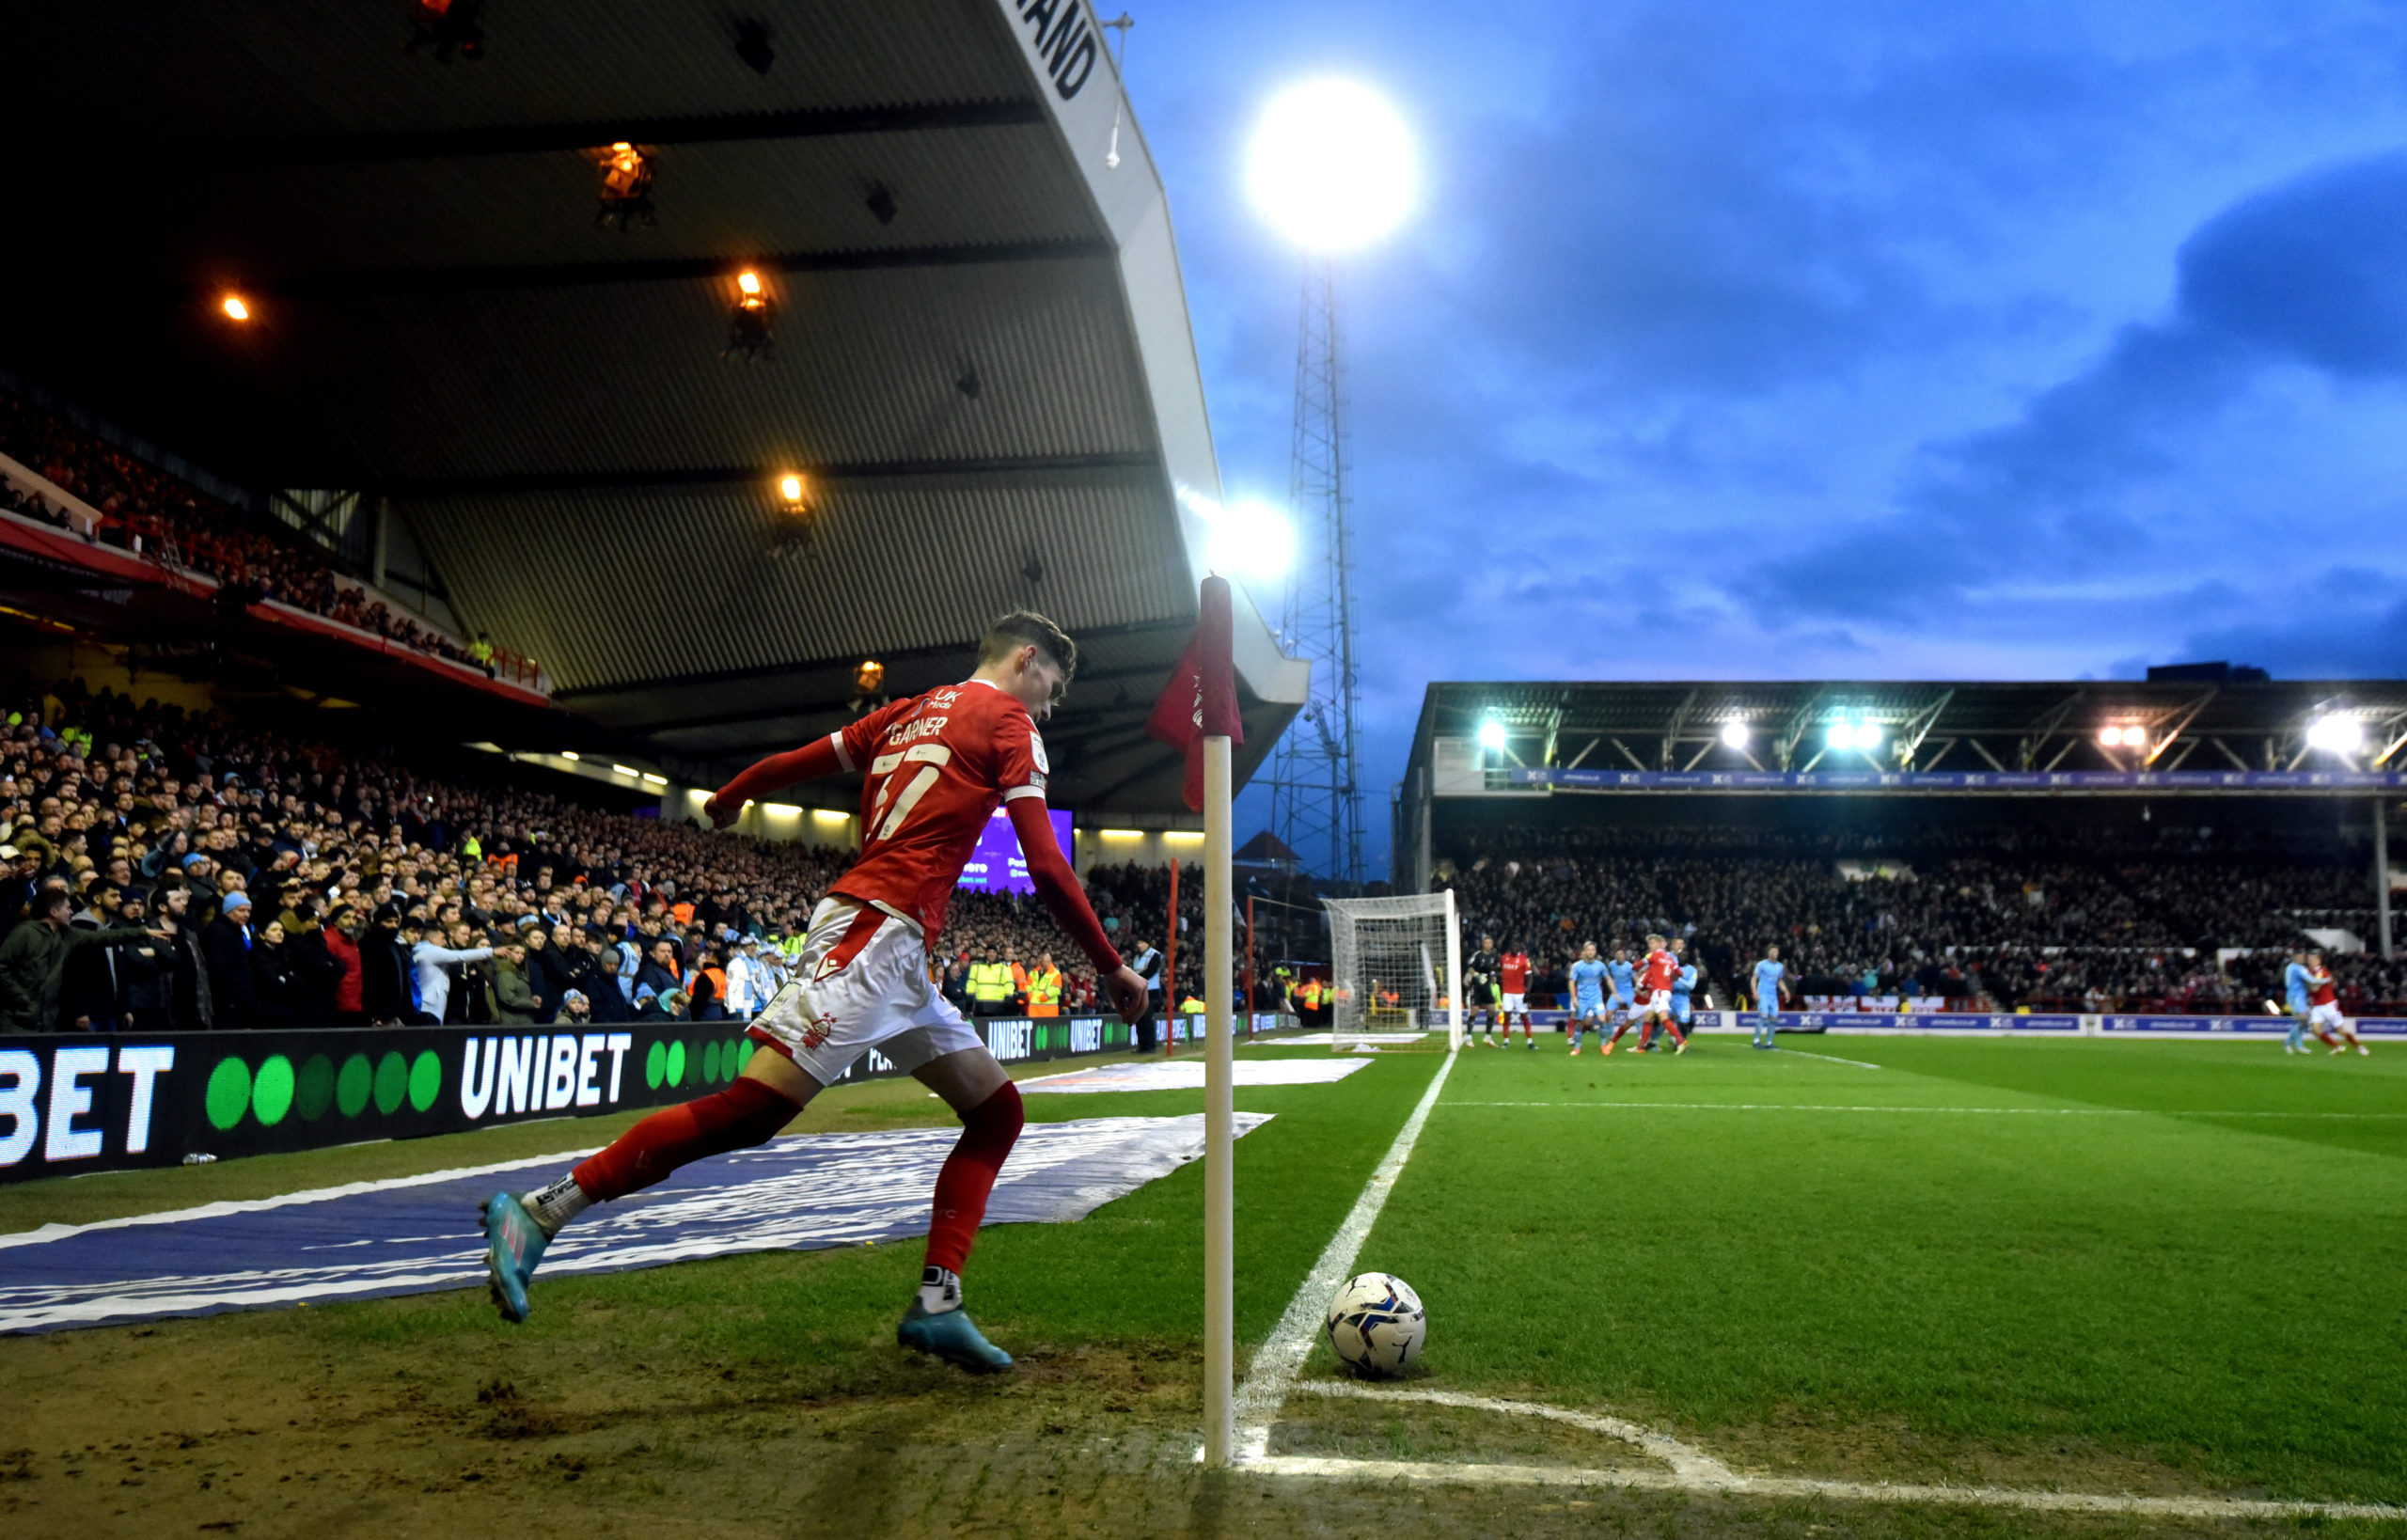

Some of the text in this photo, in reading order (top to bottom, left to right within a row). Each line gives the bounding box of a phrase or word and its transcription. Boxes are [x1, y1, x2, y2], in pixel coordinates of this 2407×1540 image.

[1015, 0, 1096, 101] AND
[935, 688, 963, 702] UK
[889, 716, 949, 746] GARNER
[987, 1019, 1033, 1061] UNIBET
[1070, 1018, 1103, 1053] UNIBET
[461, 1032, 633, 1120] UNIBET
